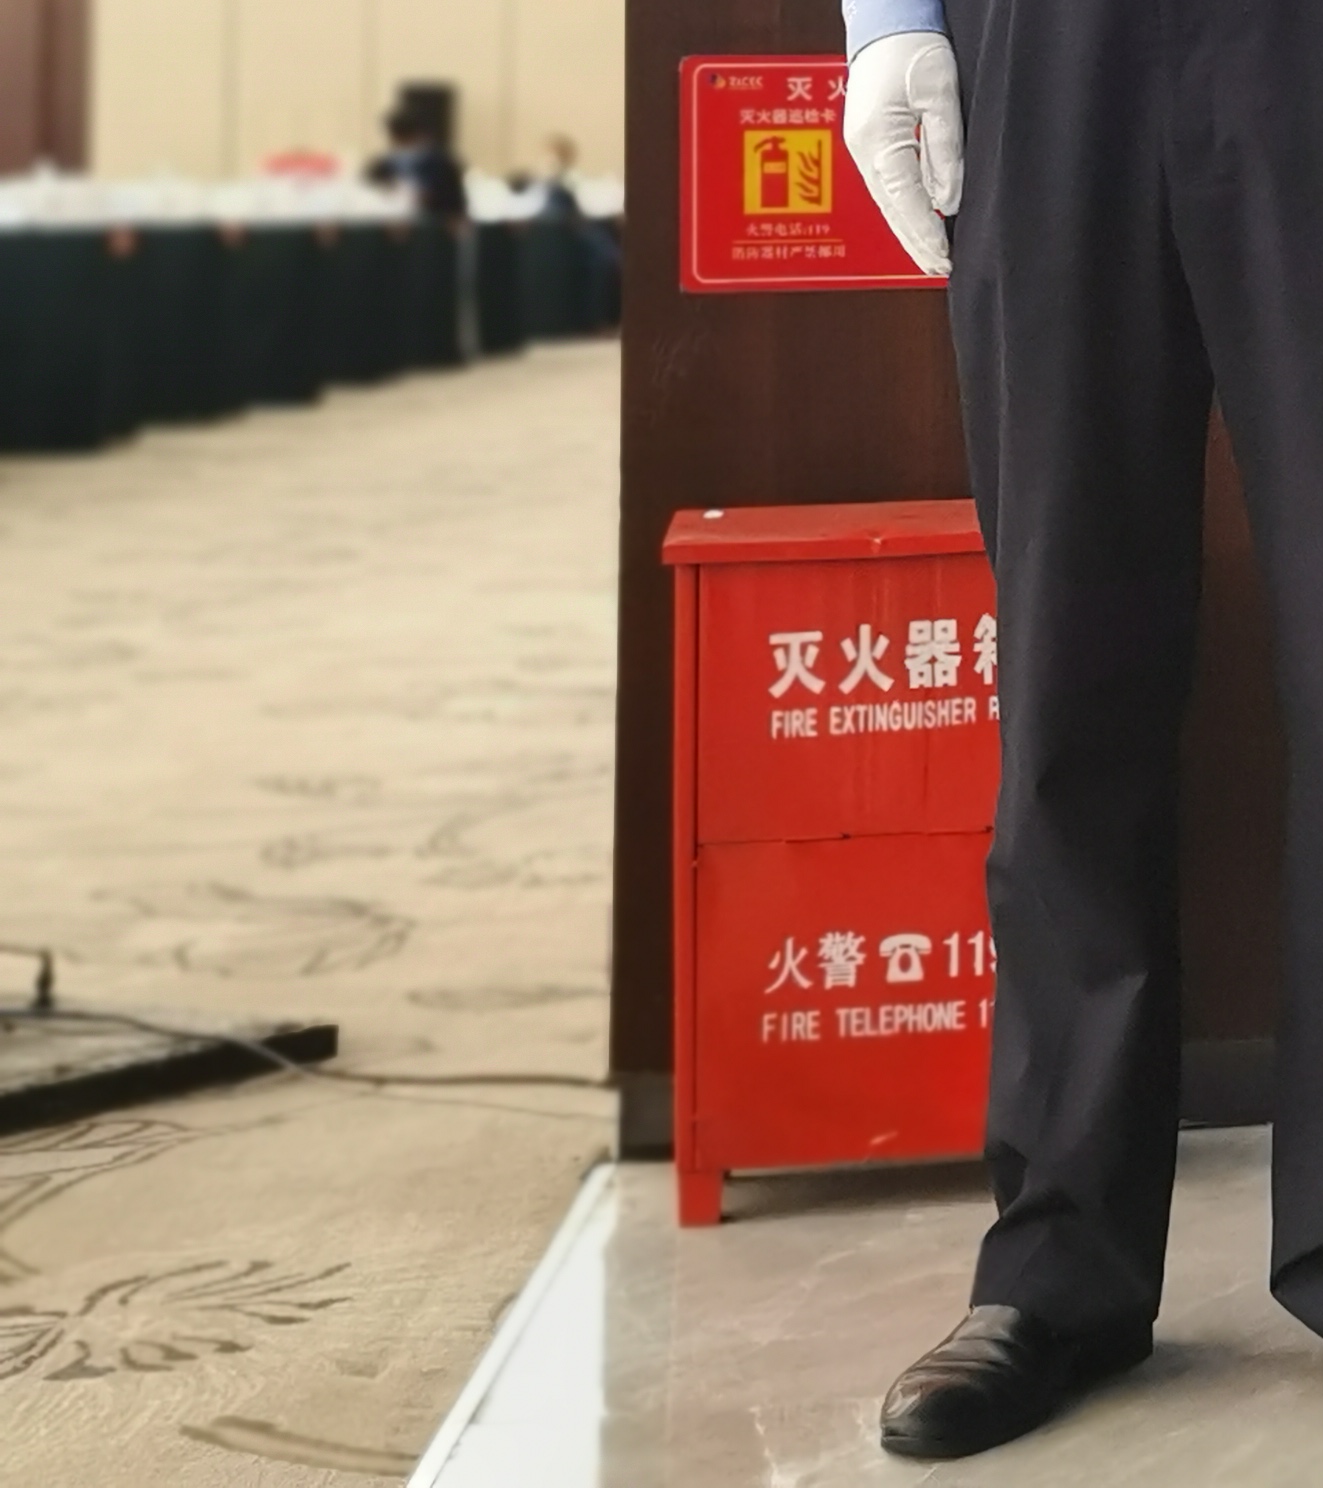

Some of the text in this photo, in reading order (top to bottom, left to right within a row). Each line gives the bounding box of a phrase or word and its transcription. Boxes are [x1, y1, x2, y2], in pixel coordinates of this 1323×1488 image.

[771, 707, 818, 739] FIRE
[830, 697, 977, 735] EXTINGUISHER
[764, 931, 866, 994] 火警
[762, 1012, 820, 1043] FIRE
[837, 1000, 967, 1038] TELEPHONE
